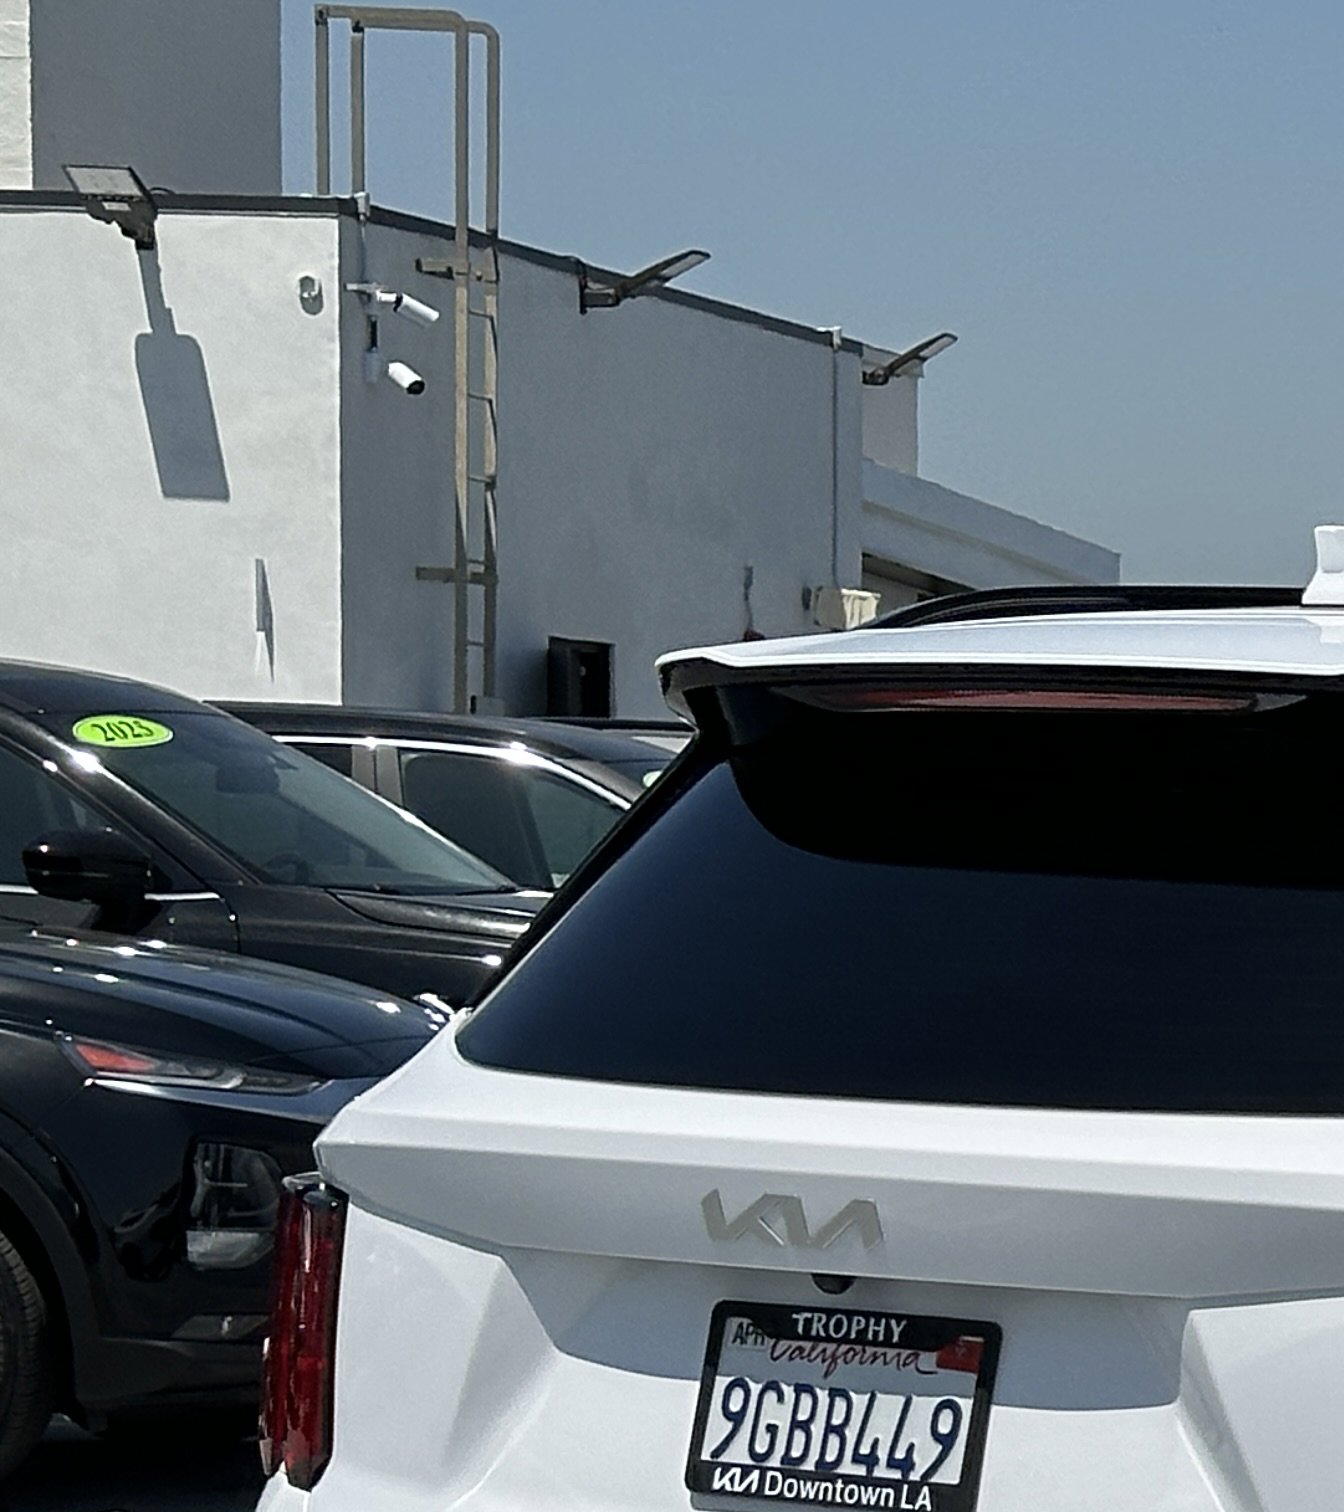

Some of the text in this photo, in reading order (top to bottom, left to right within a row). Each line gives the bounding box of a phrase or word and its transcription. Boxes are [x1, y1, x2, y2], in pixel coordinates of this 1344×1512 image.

[700, 1188, 885, 1250] KIA
[792, 1312, 908, 1344] TROPHY
[710, 1376, 963, 1482] 9GBB449
[712, 1466, 932, 1512] KIA Downtown LA
